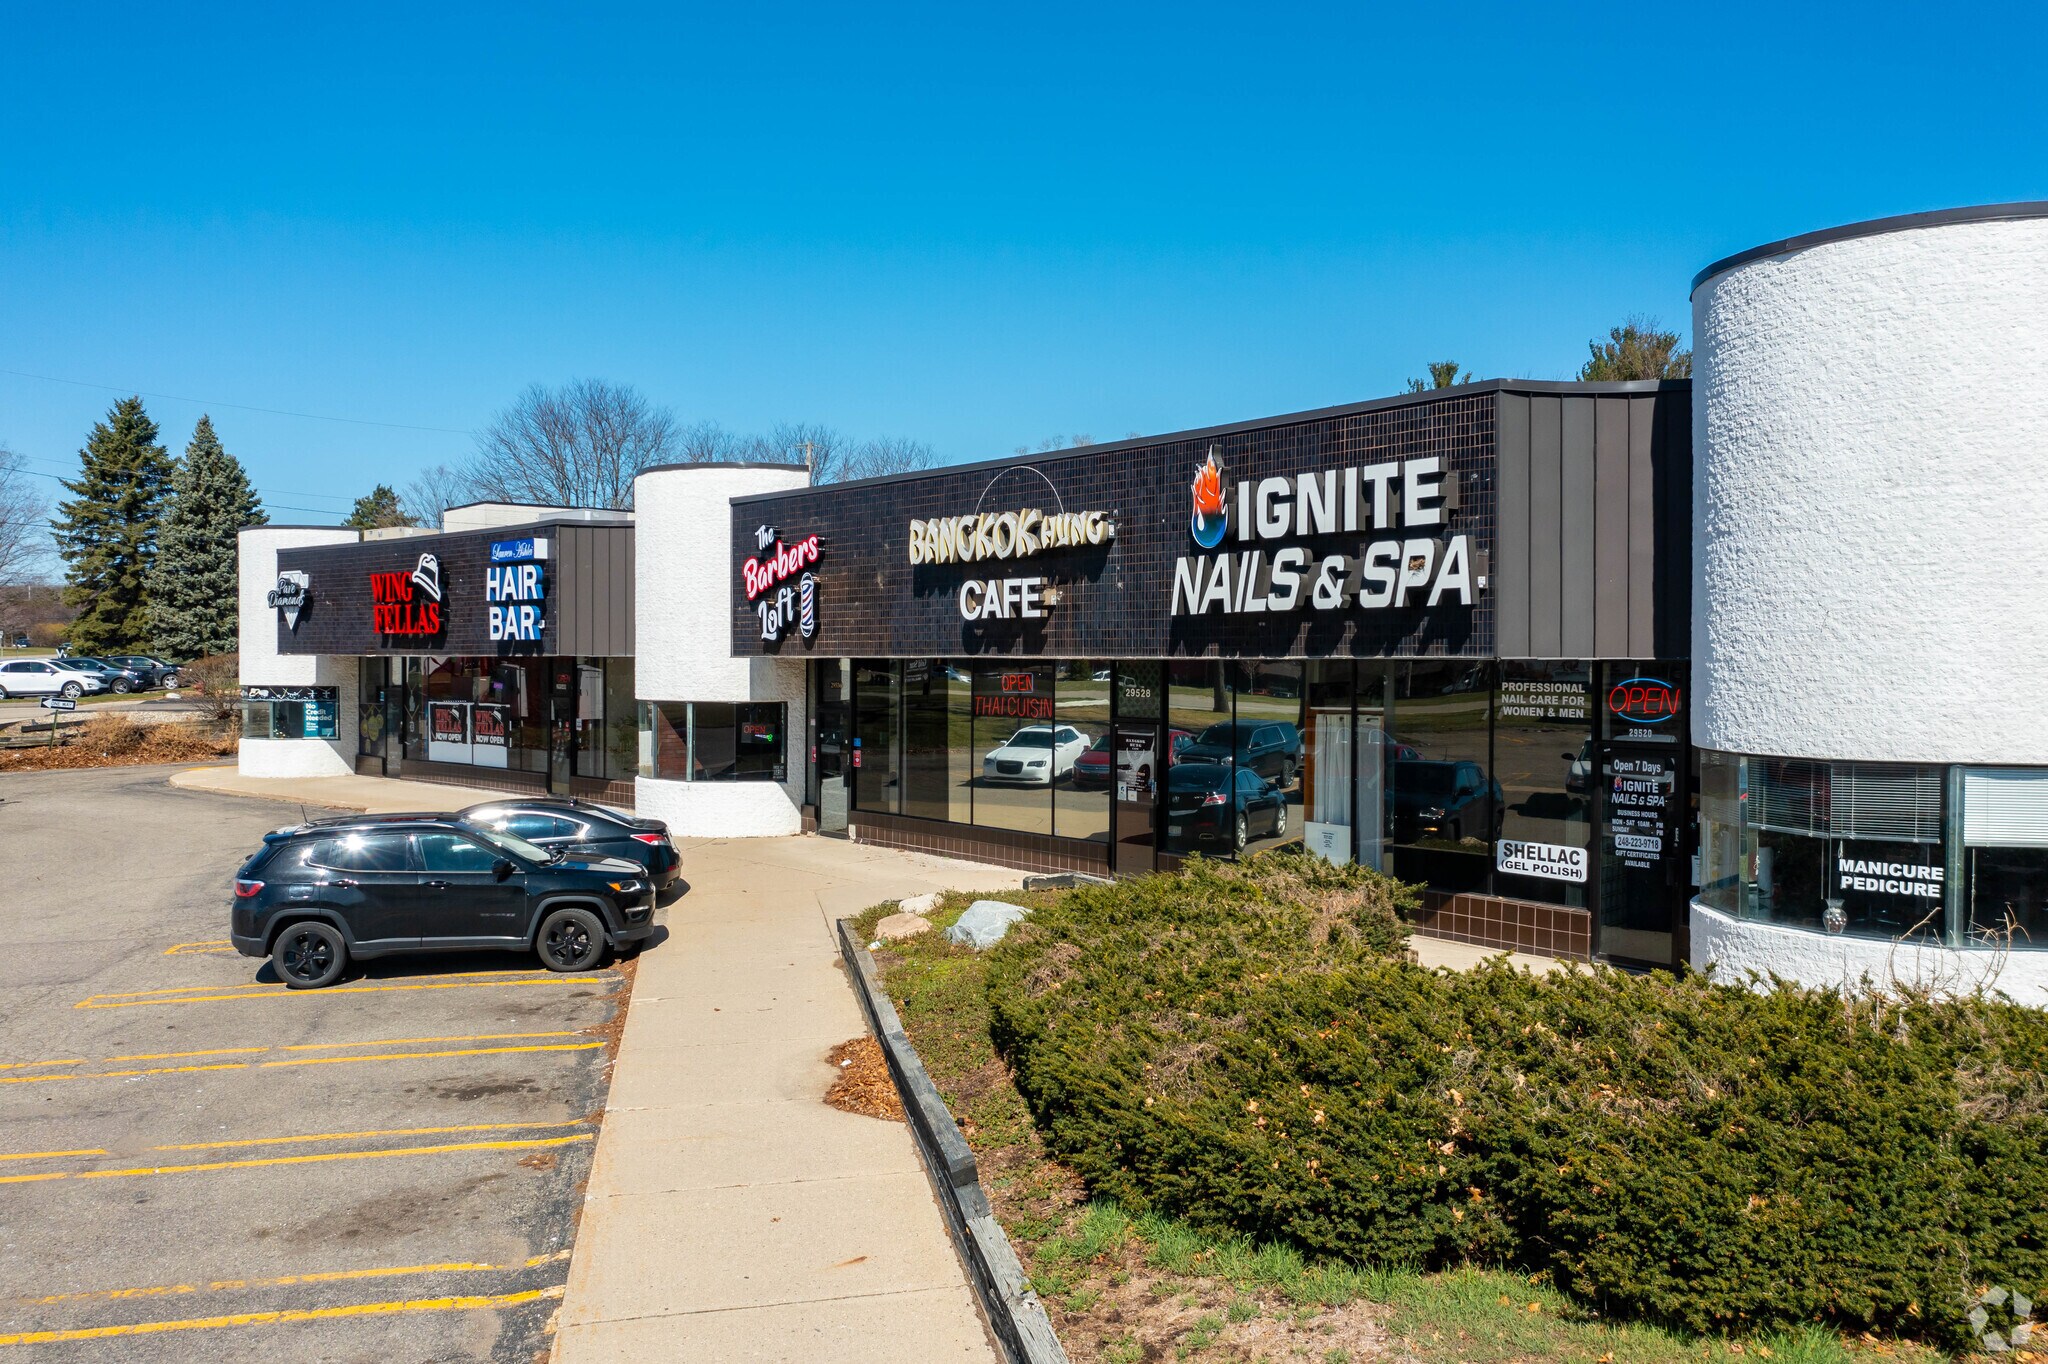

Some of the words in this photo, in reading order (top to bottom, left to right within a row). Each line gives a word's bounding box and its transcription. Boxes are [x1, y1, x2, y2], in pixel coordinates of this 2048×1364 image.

[1238, 456, 1440, 541] IGNITE
[755, 524, 775, 551] The
[909, 508, 1043, 565] BANGKOK
[1041, 511, 1105, 548] HUNG
[742, 534, 819, 601] Barbers
[1171, 547, 1304, 616] NAILS
[1313, 555, 1345, 609] &
[1359, 535, 1472, 608] SPA
[370, 571, 413, 602] WING
[486, 564, 538, 602] HAIR
[269, 589, 306, 608] Diamonds
[960, 577, 1041, 620] CAFE
[373, 602, 440, 633] FELLAS
[489, 605, 536, 641] BAR
[758, 587, 795, 640] Loft
[1002, 675, 1033, 691] OPEN
[1501, 681, 1586, 693] PROFESSIONAL
[1125, 688, 1151, 698] 29528
[1501, 694, 1526, 704] NAIL
[1529, 694, 1559, 705] CARE
[1562, 696, 1585, 706] FOR
[1608, 685, 1681, 714] OPEN
[975, 696, 1005, 716] THAI
[1503, 706, 1544, 717] WOMEN
[1547, 707, 1556, 717] &
[1559, 708, 1584, 718] MEN
[435, 732, 448, 741] NOW
[448, 733, 462, 742] OPEN
[743, 725, 766, 734] OPEN
[1628, 728, 1653, 738] 29520
[476, 734, 489, 744] NOW
[490, 736, 505, 745] OPEN
[1613, 759, 1634, 773] Open
[1635, 760, 1641, 771] 7
[1642, 761, 1661, 775] Days
[1623, 780, 1659, 794] IGNITE
[1611, 792, 1638, 805] NAILS
[1638, 796, 1645, 806] &
[1646, 795, 1665, 807] SPA
[1617, 809, 1640, 817] BUSINESS
[1640, 811, 1658, 819] HOURS
[1612, 825, 1630, 833] SUNDAY
[1617, 836, 1659, 850] 248-223-9718
[1503, 842, 1581, 866] SHELLAC
[1626, 851, 1660, 860] CERTIFICATES
[1501, 859, 1529, 872] (GEL
[1532, 864, 1583, 880] POLISH)
[1624, 859, 1650, 869] AVAILABLE
[1839, 858, 1945, 881] MANICURE
[1840, 875, 1941, 898] PEDICURE
